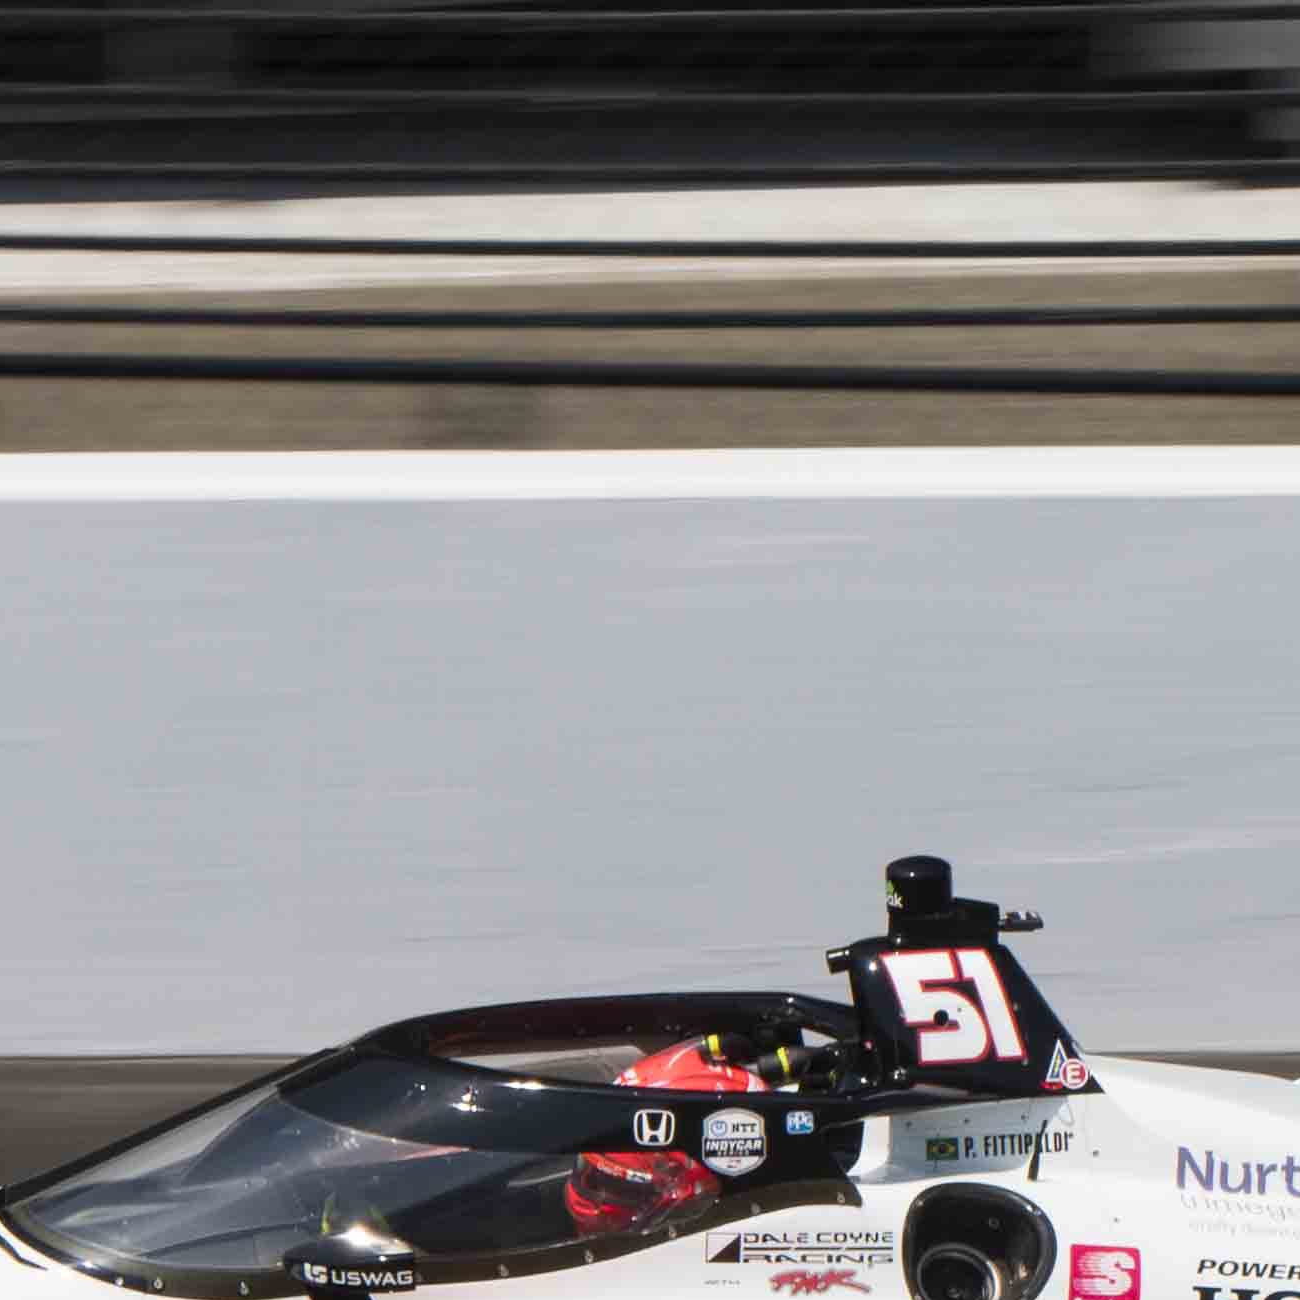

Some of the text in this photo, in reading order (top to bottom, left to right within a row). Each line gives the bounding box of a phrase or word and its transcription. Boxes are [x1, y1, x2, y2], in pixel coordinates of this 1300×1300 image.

[879, 947, 1028, 1068] 51
[705, 1138, 762, 1152] INDYCAR
[963, 1136, 978, 1158] P.
[743, 1231, 894, 1244] DALE COYNE
[331, 1270, 414, 1287] USWAG
